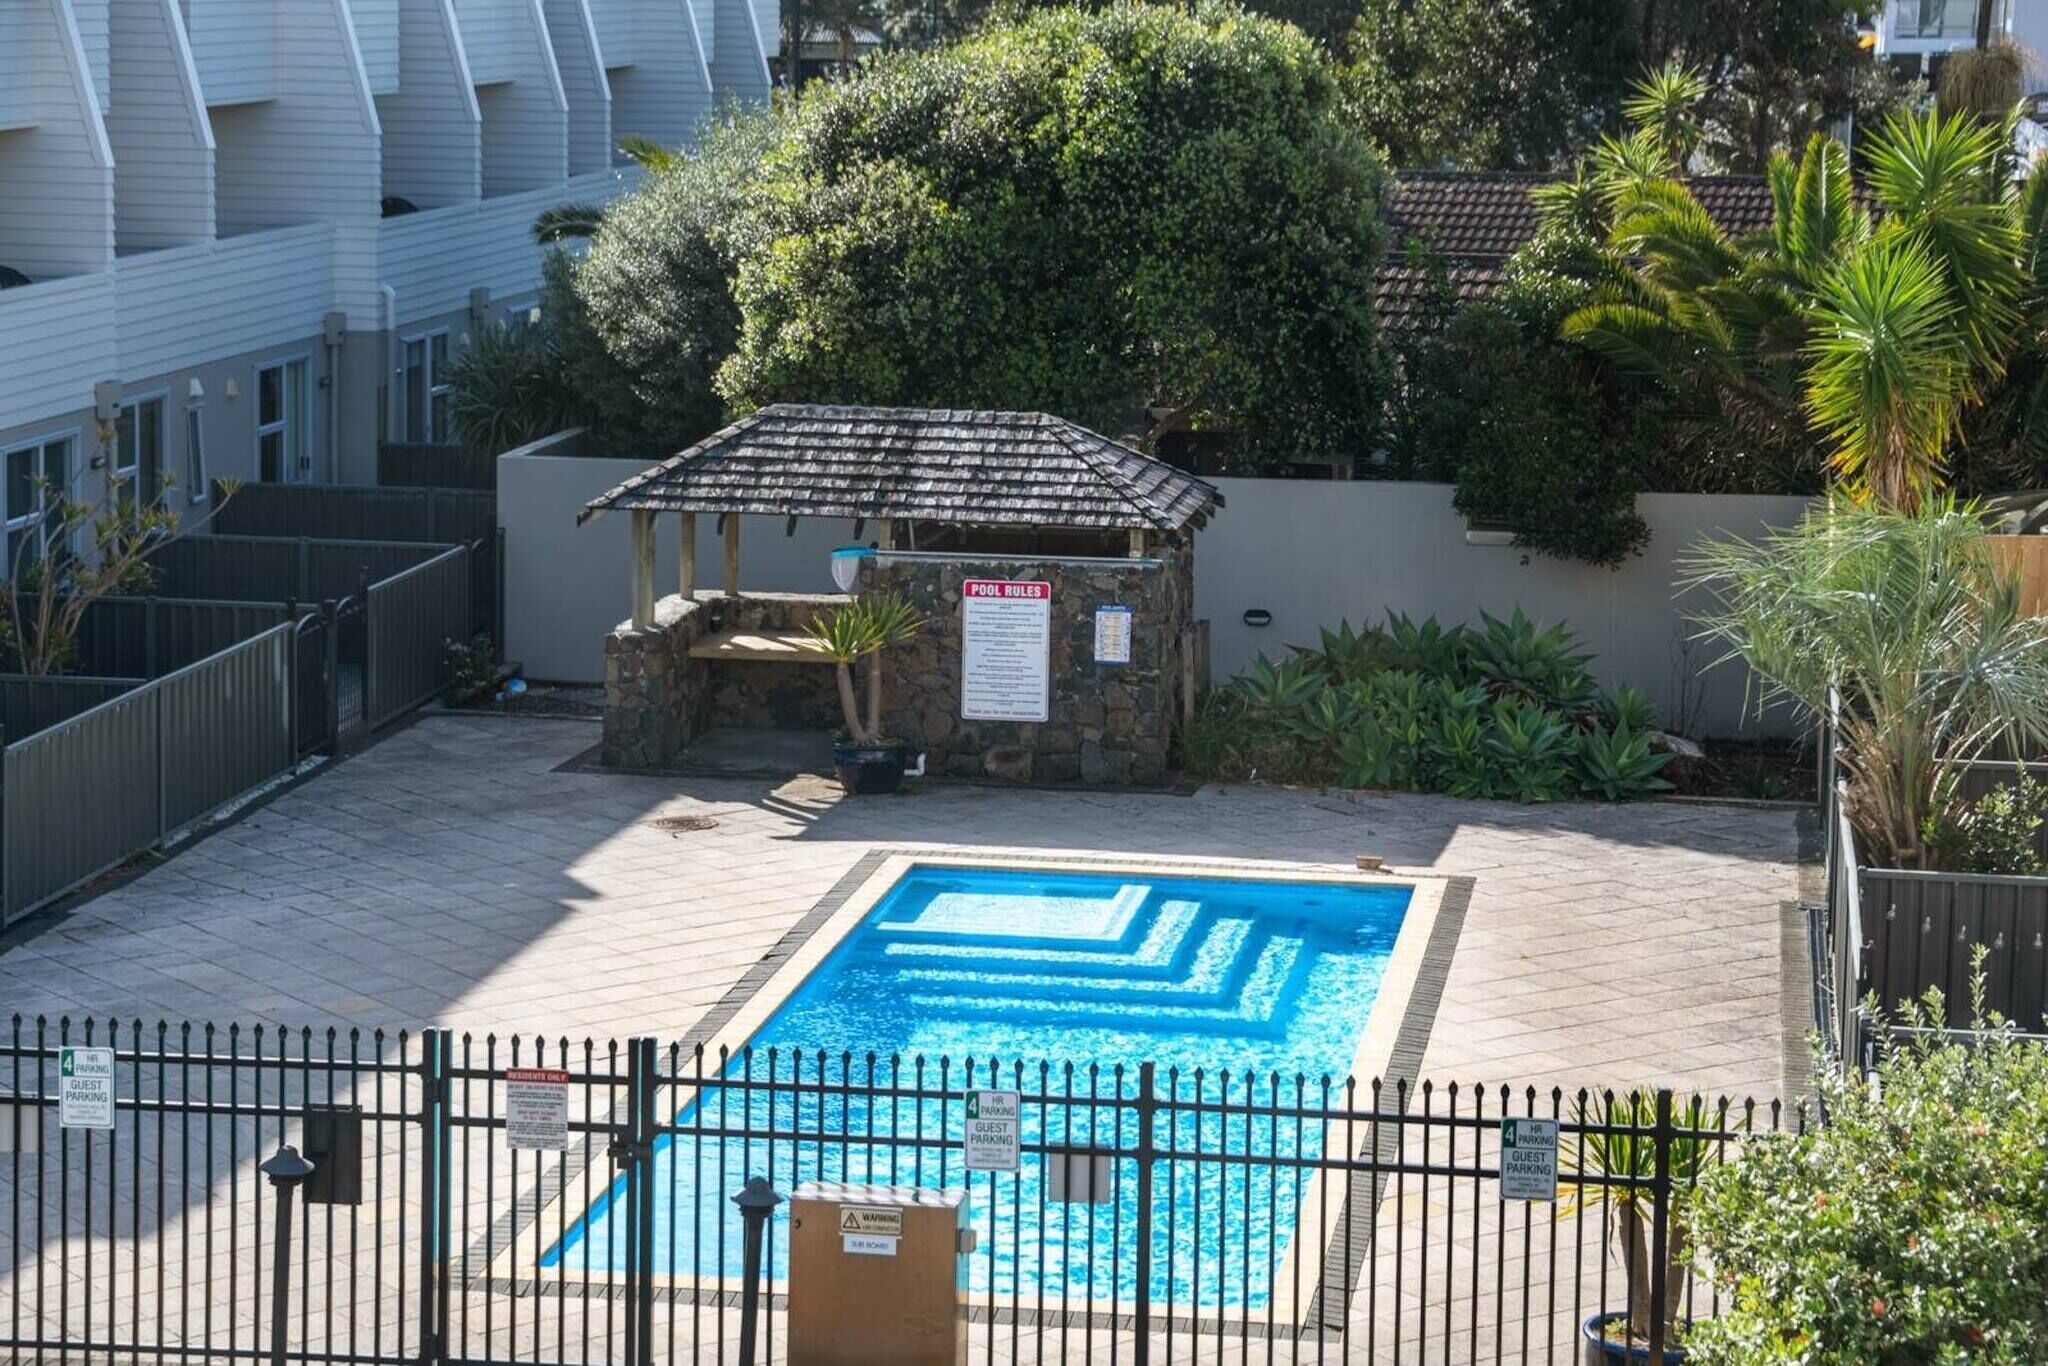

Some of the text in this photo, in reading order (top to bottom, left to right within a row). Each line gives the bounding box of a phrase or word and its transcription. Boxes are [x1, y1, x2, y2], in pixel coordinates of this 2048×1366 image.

[971, 584, 1041, 597] POOL RULES
[63, 1055, 73, 1072] 4
[76, 1064, 109, 1074] PARKING
[71, 1080, 102, 1091] GUEST
[66, 1091, 107, 1103] PARKING
[992, 1096, 1004, 1105] HR
[968, 1097, 977, 1115] 4
[981, 1106, 1015, 1117] PARKING
[976, 1122, 1008, 1133] GUEST
[1530, 1124, 1542, 1133] HR
[971, 1134, 1013, 1146] PARKING
[1505, 1126, 1515, 1143] 4
[1518, 1134, 1554, 1146] PARKING
[1512, 1150, 1546, 1163] GUEST
[1506, 1162, 1552, 1176] PARKING
[862, 1212, 899, 1223] WARNING
